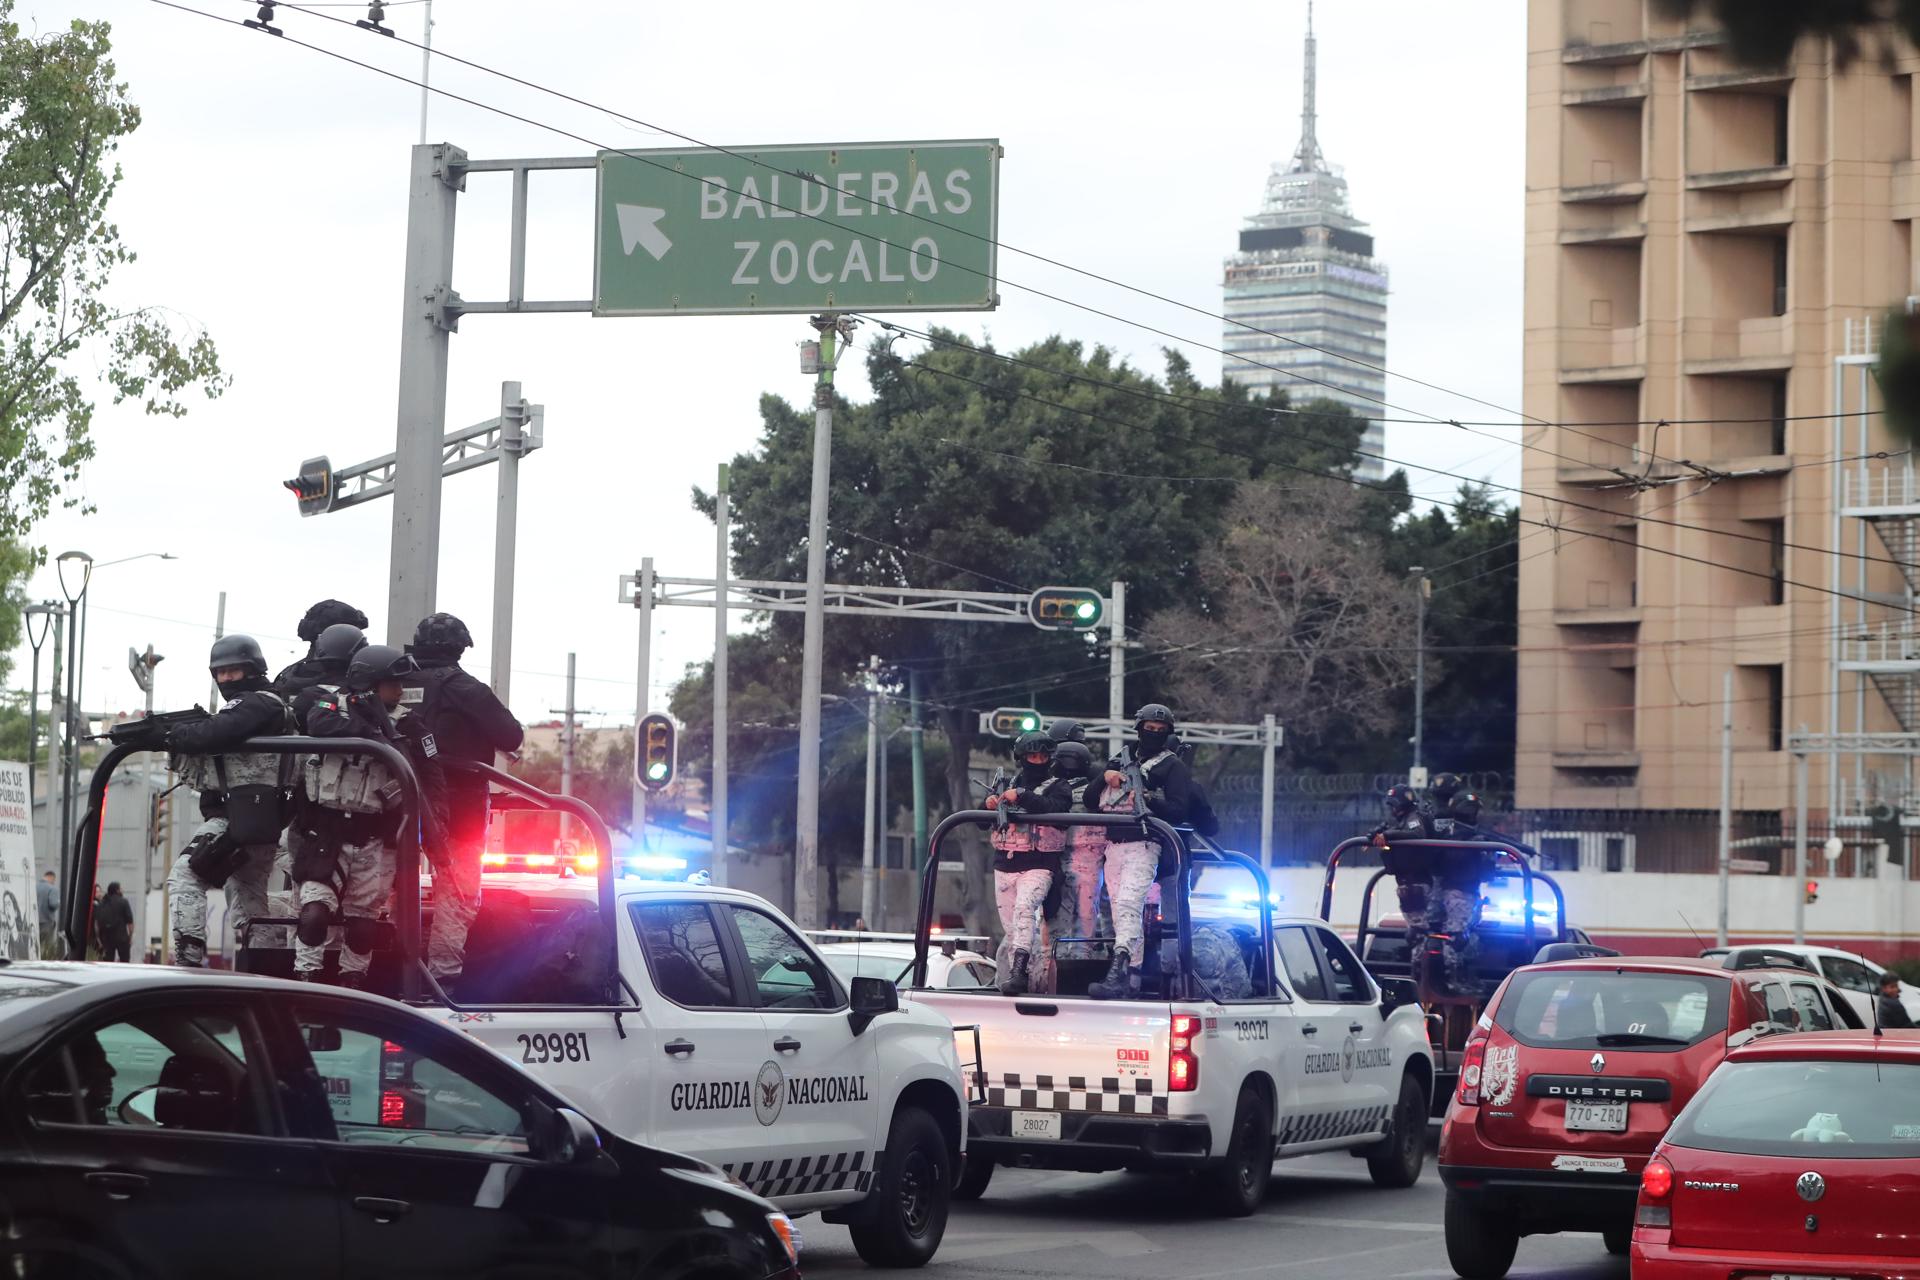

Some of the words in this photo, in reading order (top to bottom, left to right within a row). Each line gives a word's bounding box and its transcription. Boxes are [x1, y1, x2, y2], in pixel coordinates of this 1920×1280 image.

[701, 169, 973, 220] BALDERAS
[731, 236, 939, 285] ZOCALO
[12, 771, 22, 787] DE
[1234, 1019, 1269, 1041] 28027
[1628, 1022, 1646, 1034] 01
[517, 1032, 590, 1064] 29981
[1117, 1049, 1149, 1060] 911
[1305, 1052, 1340, 1074] GUARDIA
[1356, 1047, 1391, 1069] NACIONAL
[671, 1081, 751, 1111] GUARDIA
[788, 1076, 868, 1104] NACIONAL
[1549, 1086, 1642, 1097] DUSTER
[1023, 1119, 1049, 1131] 28027
[1684, 1181, 1739, 1191] POINTER
